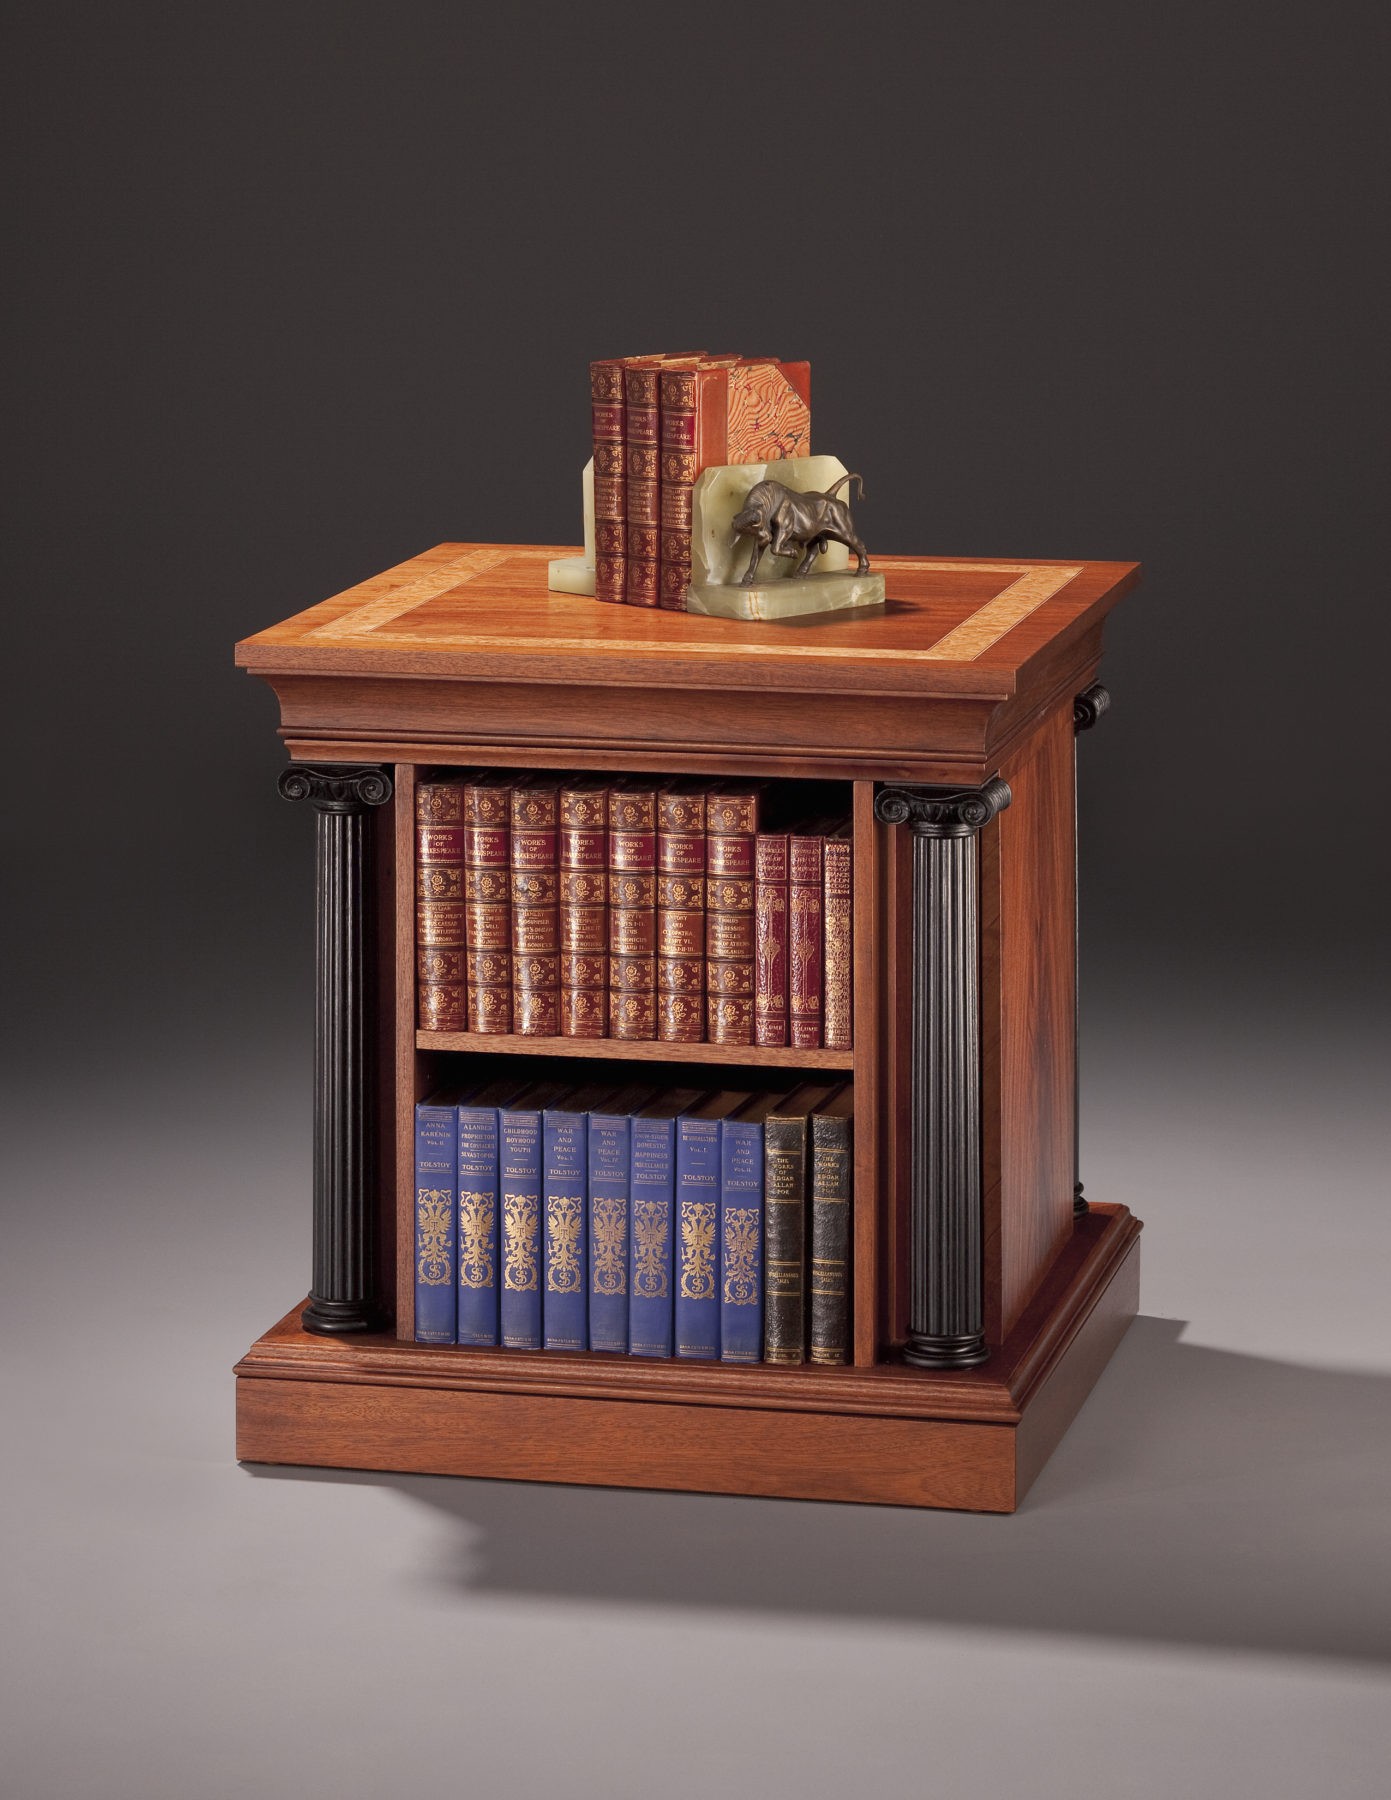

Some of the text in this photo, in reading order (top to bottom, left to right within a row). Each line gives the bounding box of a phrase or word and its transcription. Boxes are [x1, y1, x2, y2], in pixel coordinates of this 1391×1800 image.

[569, 838, 595, 846] WORKS
[617, 840, 644, 848] WORKS
[553, 1145, 576, 1153] PEACE
